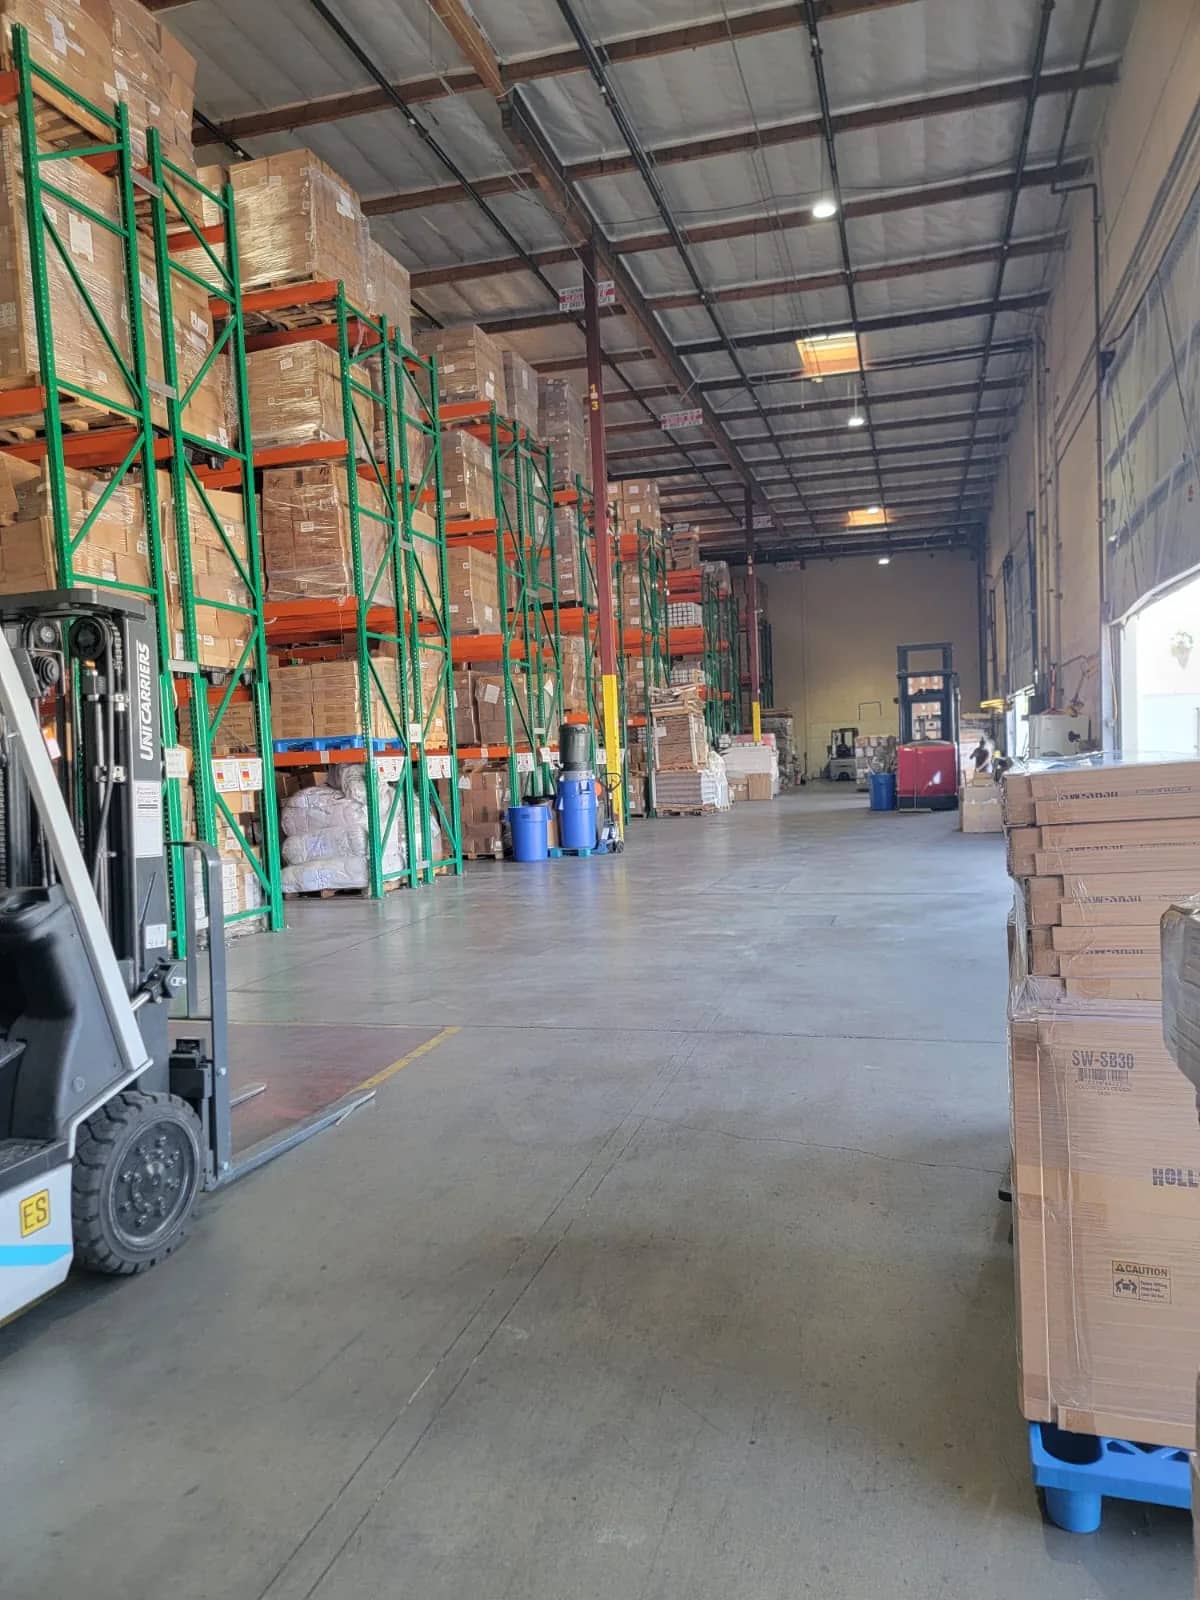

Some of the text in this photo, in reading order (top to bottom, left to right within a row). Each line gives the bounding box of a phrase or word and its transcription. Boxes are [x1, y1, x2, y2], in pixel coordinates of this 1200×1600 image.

[136, 640, 153, 760] UNICARRIERS
[1071, 1049, 1135, 1070] SW-SB30
[1152, 1167, 1200, 1188] HOLL
[23, 1196, 47, 1230] ES
[1125, 1264, 1168, 1278] CAUTION
